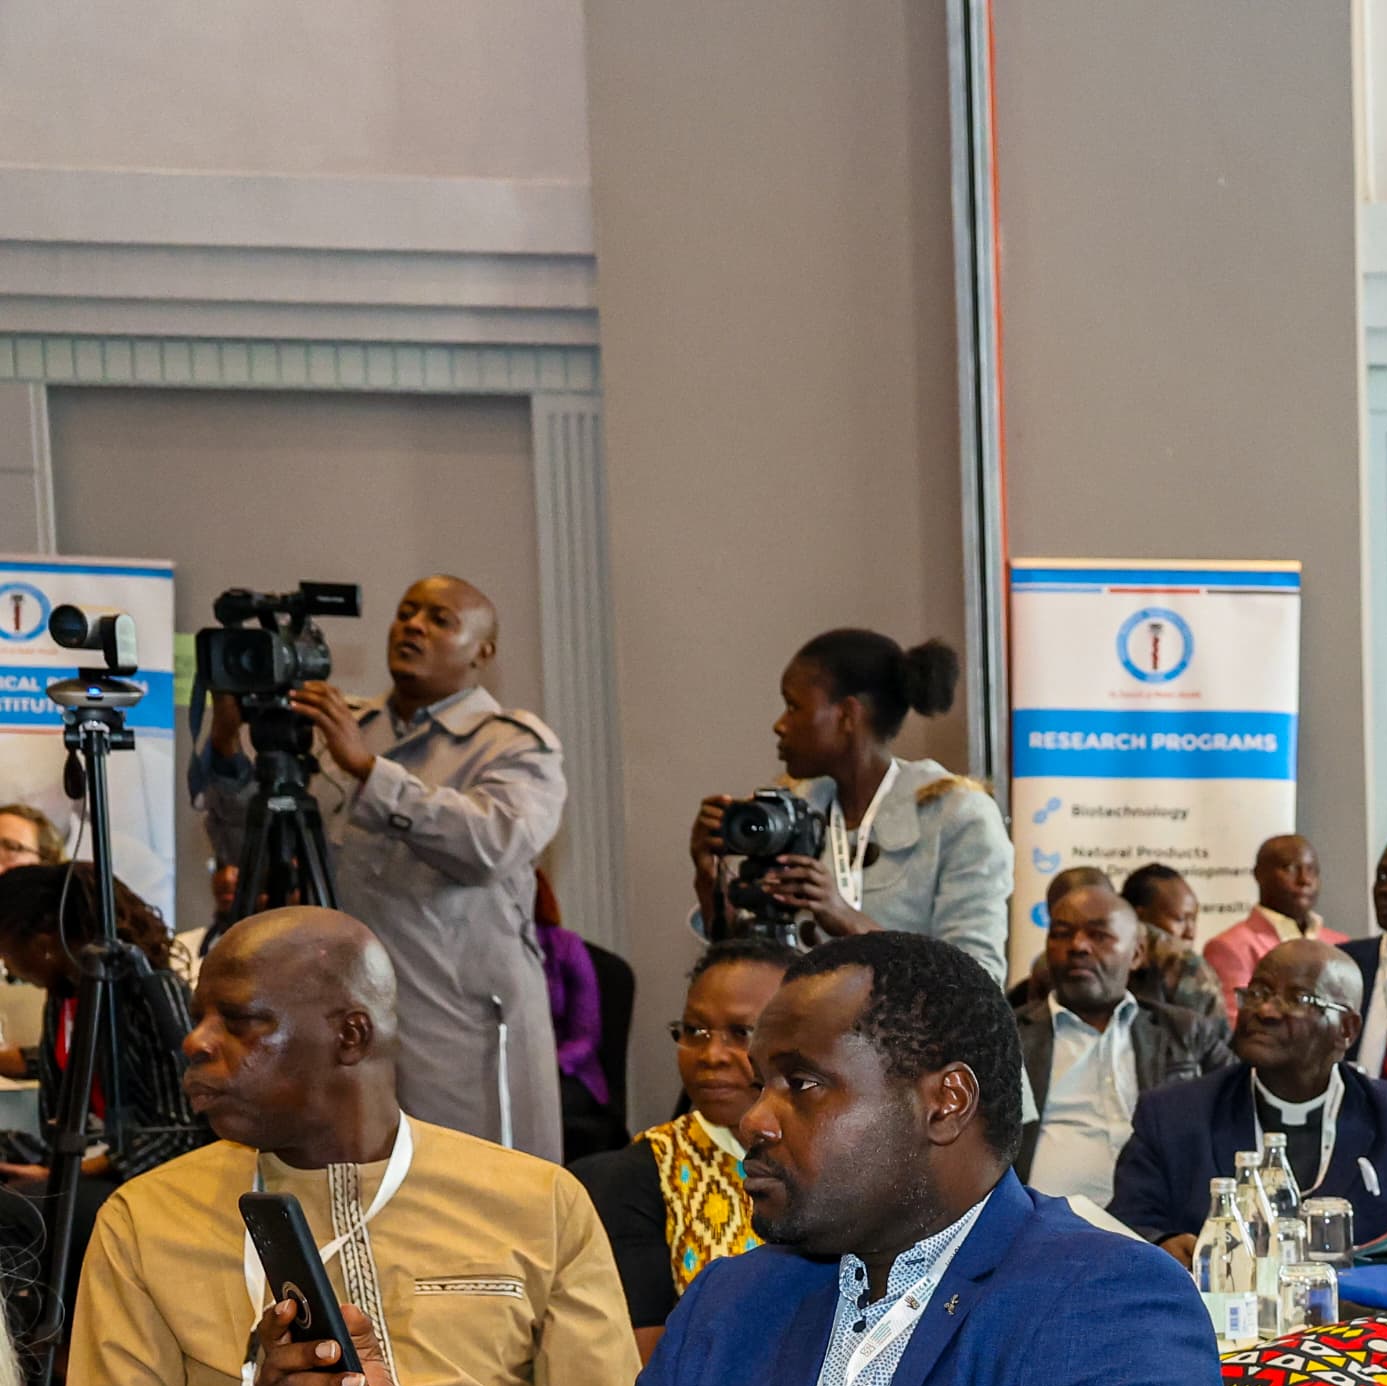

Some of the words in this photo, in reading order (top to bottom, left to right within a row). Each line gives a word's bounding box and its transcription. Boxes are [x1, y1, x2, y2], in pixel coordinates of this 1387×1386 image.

[0, 675, 41, 692] ICAL
[1029, 731, 1146, 750] RESEARCH
[1151, 732, 1278, 752] PROGRAMS
[1072, 805, 1189, 821] Biotechnology
[1072, 846, 1132, 858] Natural
[1137, 846, 1209, 858] Products
